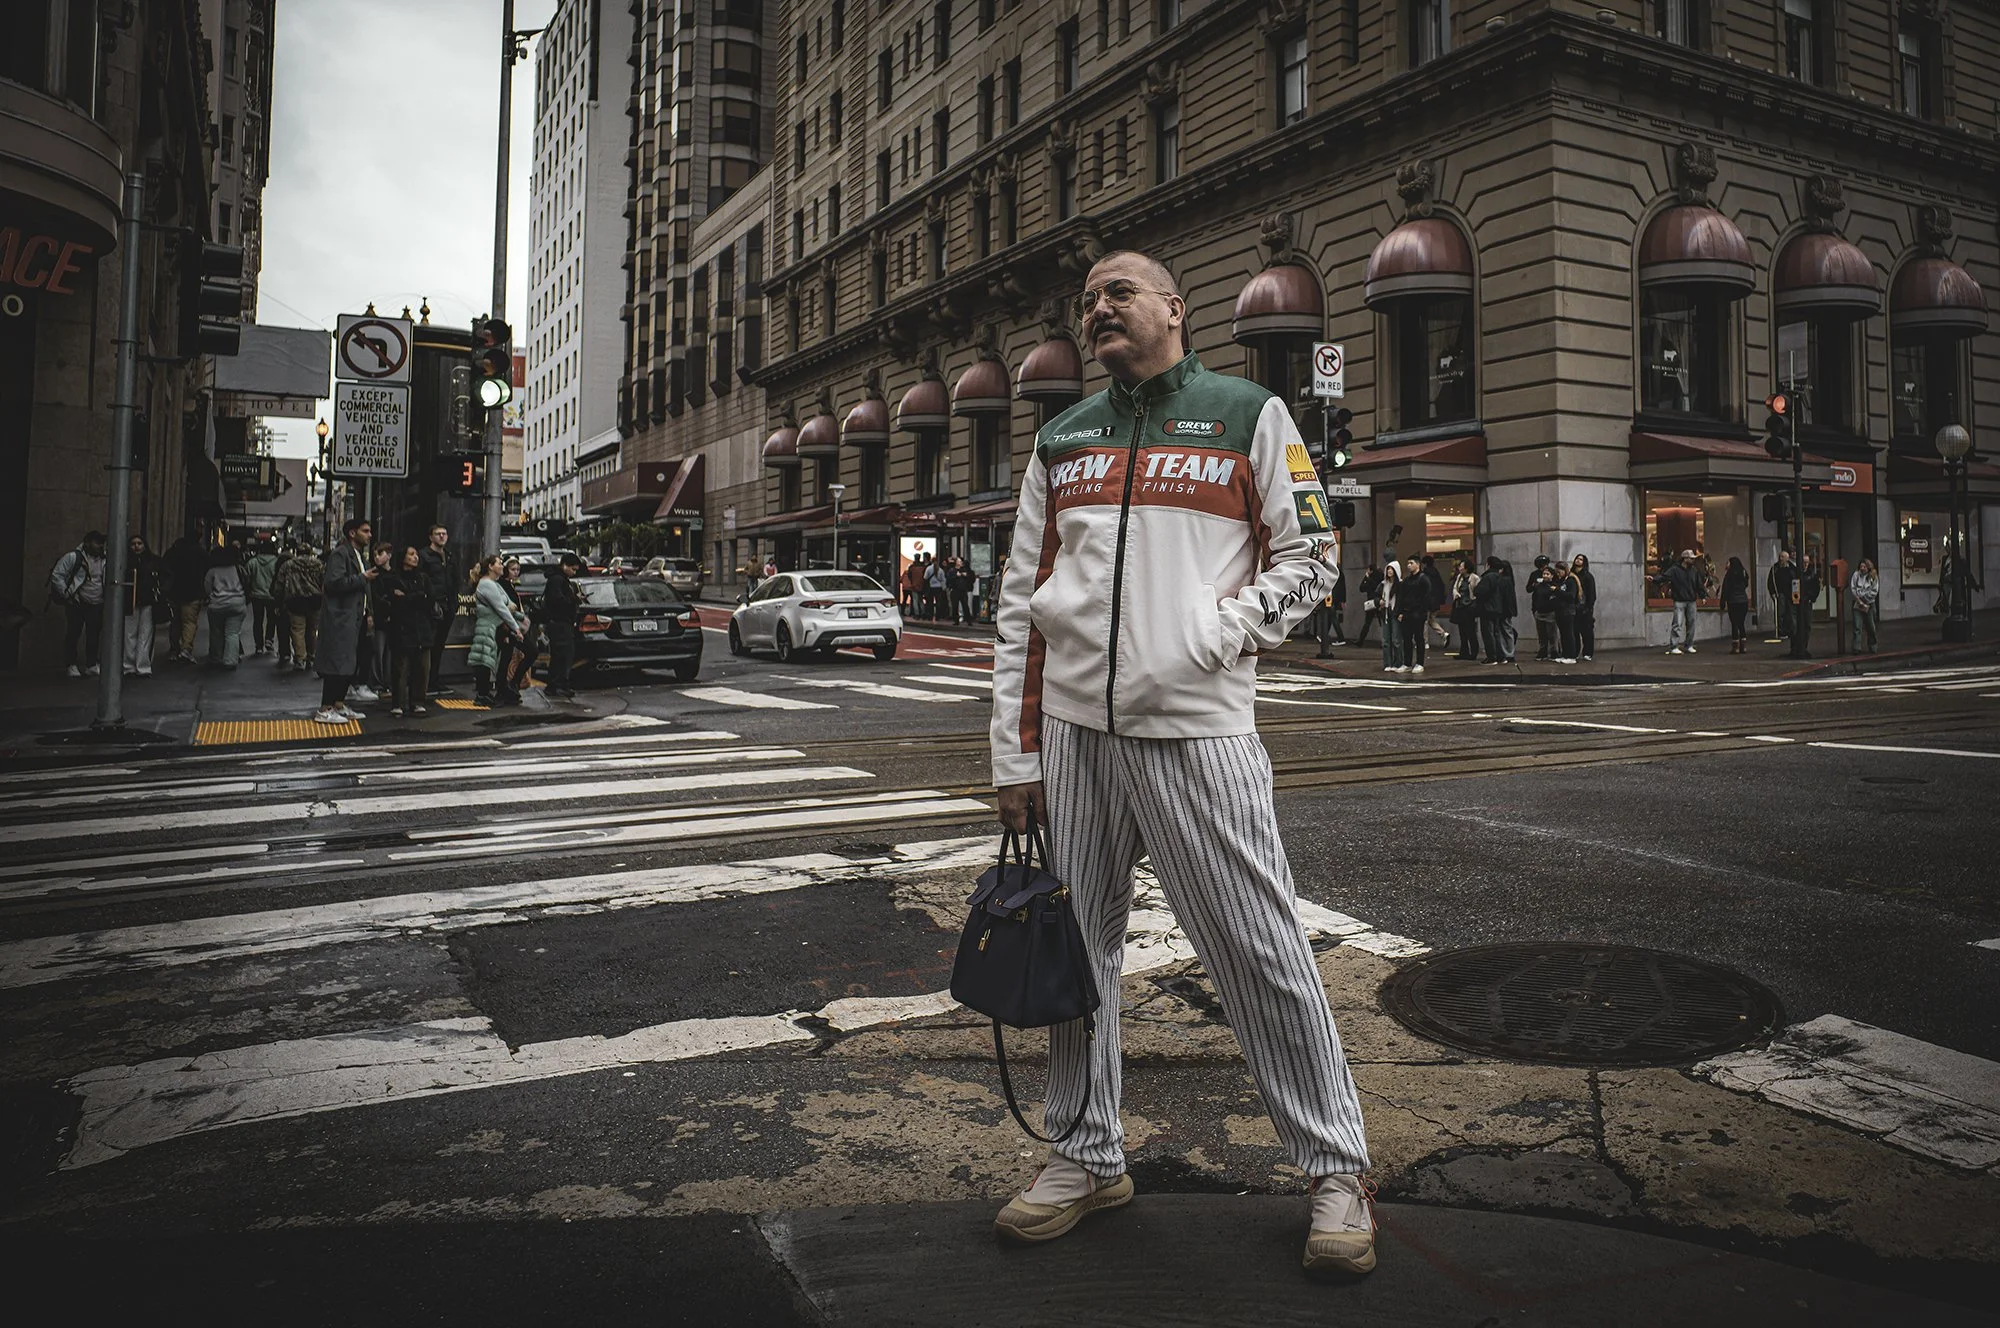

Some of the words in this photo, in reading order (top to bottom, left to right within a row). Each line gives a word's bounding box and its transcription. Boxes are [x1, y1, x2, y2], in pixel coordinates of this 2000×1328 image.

[1316, 381, 1325, 389] ON
[1327, 382, 1341, 391] RED
[352, 389, 394, 402] EXCEPT
[251, 400, 312, 412] HOTEL
[340, 400, 404, 414] COMMERCIAL
[345, 412, 399, 425] VEHICLES
[360, 424, 383, 435] AND
[1177, 421, 1214, 430] CREW
[345, 434, 398, 447] VEHICLES
[1053, 429, 1102, 443] TURBO
[346, 445, 395, 458] LOADING
[337, 456, 353, 467] ON
[359, 457, 402, 469] POWELL
[462, 462, 473, 486] 3
[1050, 454, 1116, 490] CREW
[1145, 453, 1236, 486] TEAM
[1835, 472, 1852, 482] ndo
[1060, 483, 1103, 499] RACING
[1142, 482, 1196, 495] FINISH
[1336, 486, 1362, 495] POWELL
[1305, 494, 1328, 529] 1
[537, 520, 548, 531] G
